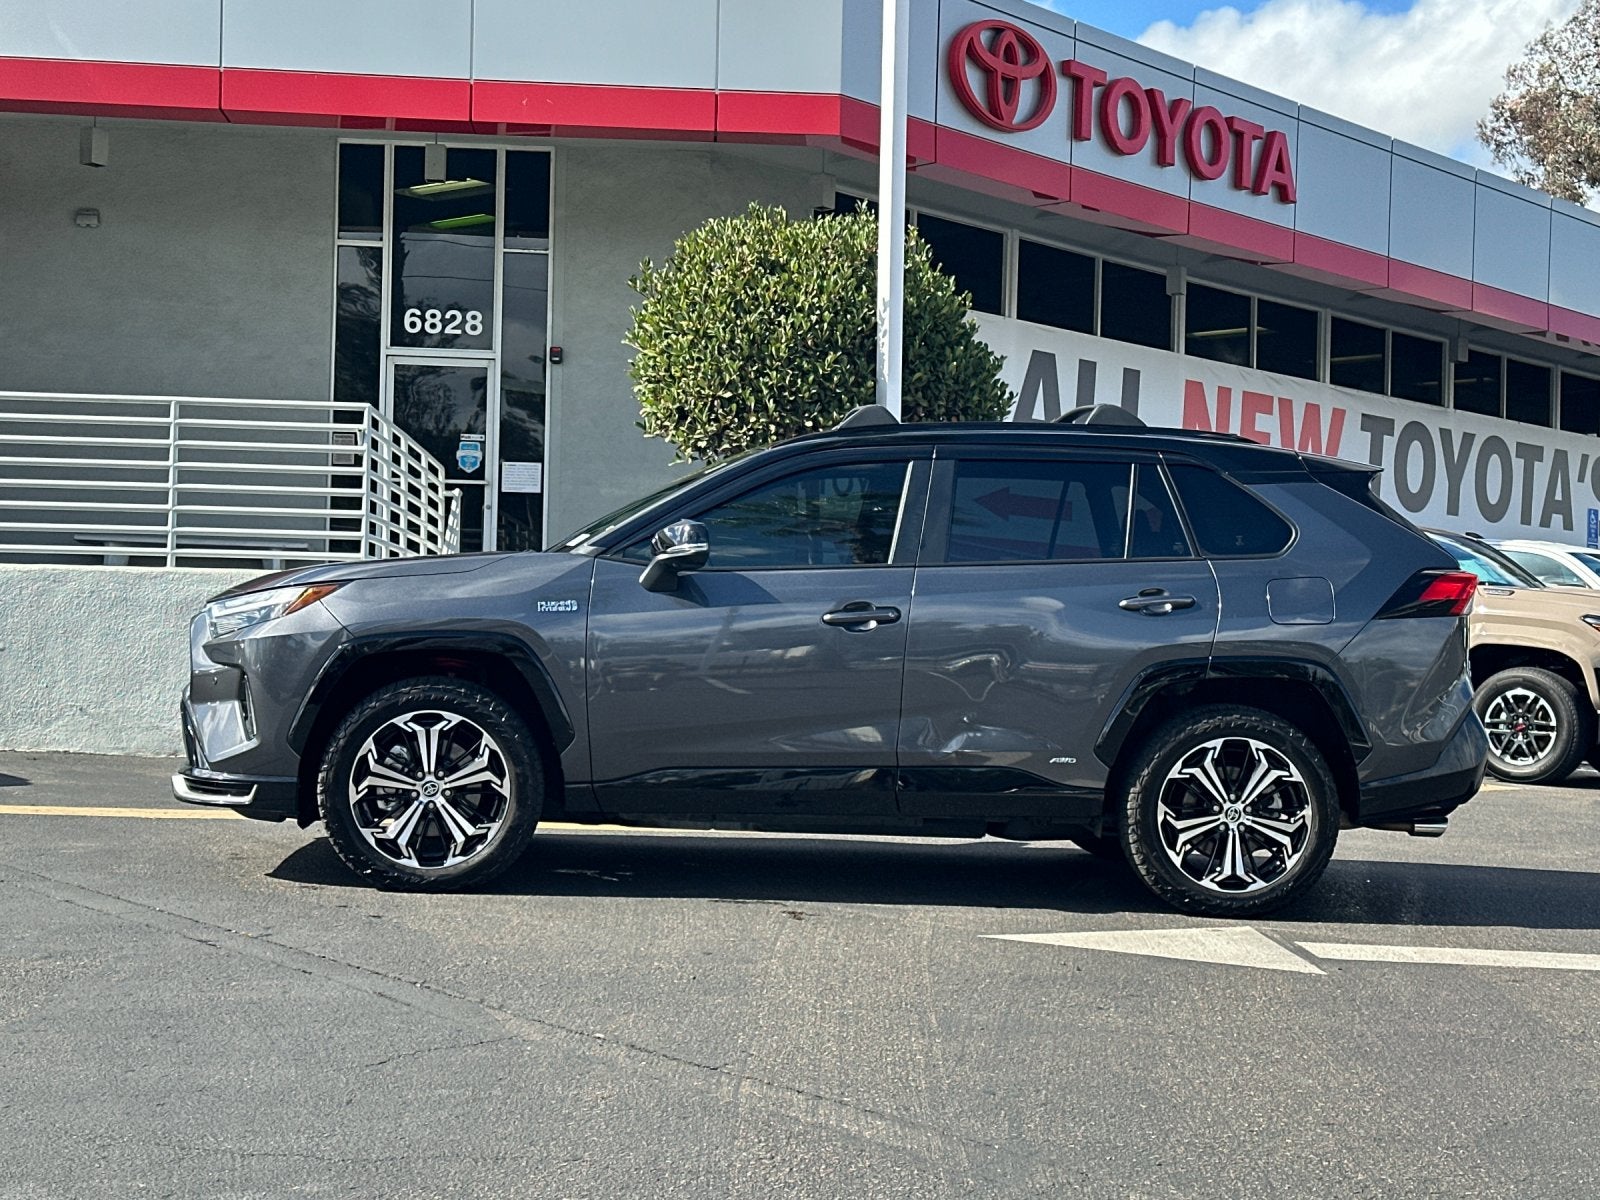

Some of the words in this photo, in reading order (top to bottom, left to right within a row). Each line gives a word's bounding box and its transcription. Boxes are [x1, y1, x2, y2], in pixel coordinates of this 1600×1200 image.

[1062, 59, 1298, 205] TOYOTA
[403, 308, 483, 336] 6828
[1360, 412, 1600, 532] TOYOTA'
